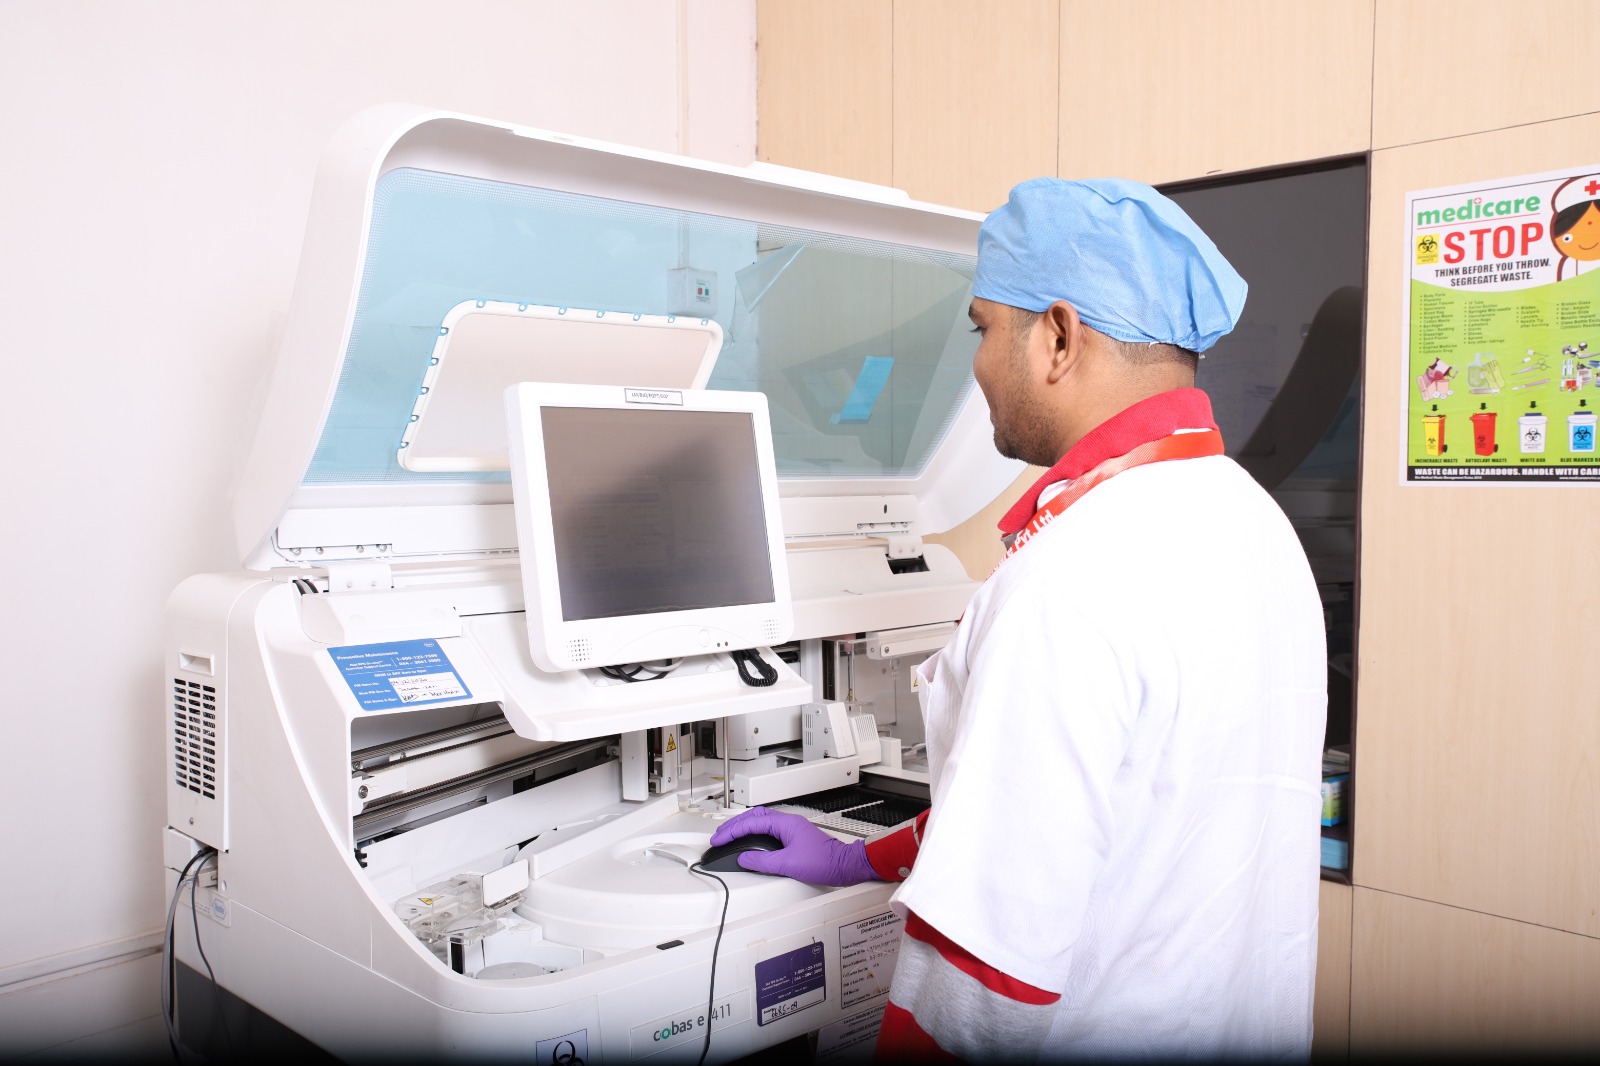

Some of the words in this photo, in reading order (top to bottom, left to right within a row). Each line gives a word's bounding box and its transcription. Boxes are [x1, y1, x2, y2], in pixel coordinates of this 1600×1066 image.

[1417, 196, 1540, 226] medicare
[1444, 222, 1543, 264] STOP
[1435, 267, 1460, 277] THINK
[1462, 264, 1493, 275] BEFORE
[1496, 262, 1513, 272] YOU
[1515, 258, 1551, 270] THROW.
[1450, 275, 1498, 287] SEGREGATE
[1500, 271, 1533, 282] WASTE.
[654, 1020, 692, 1041] cobas
[697, 1016, 704, 1026] e
[711, 1003, 731, 1020] 411
